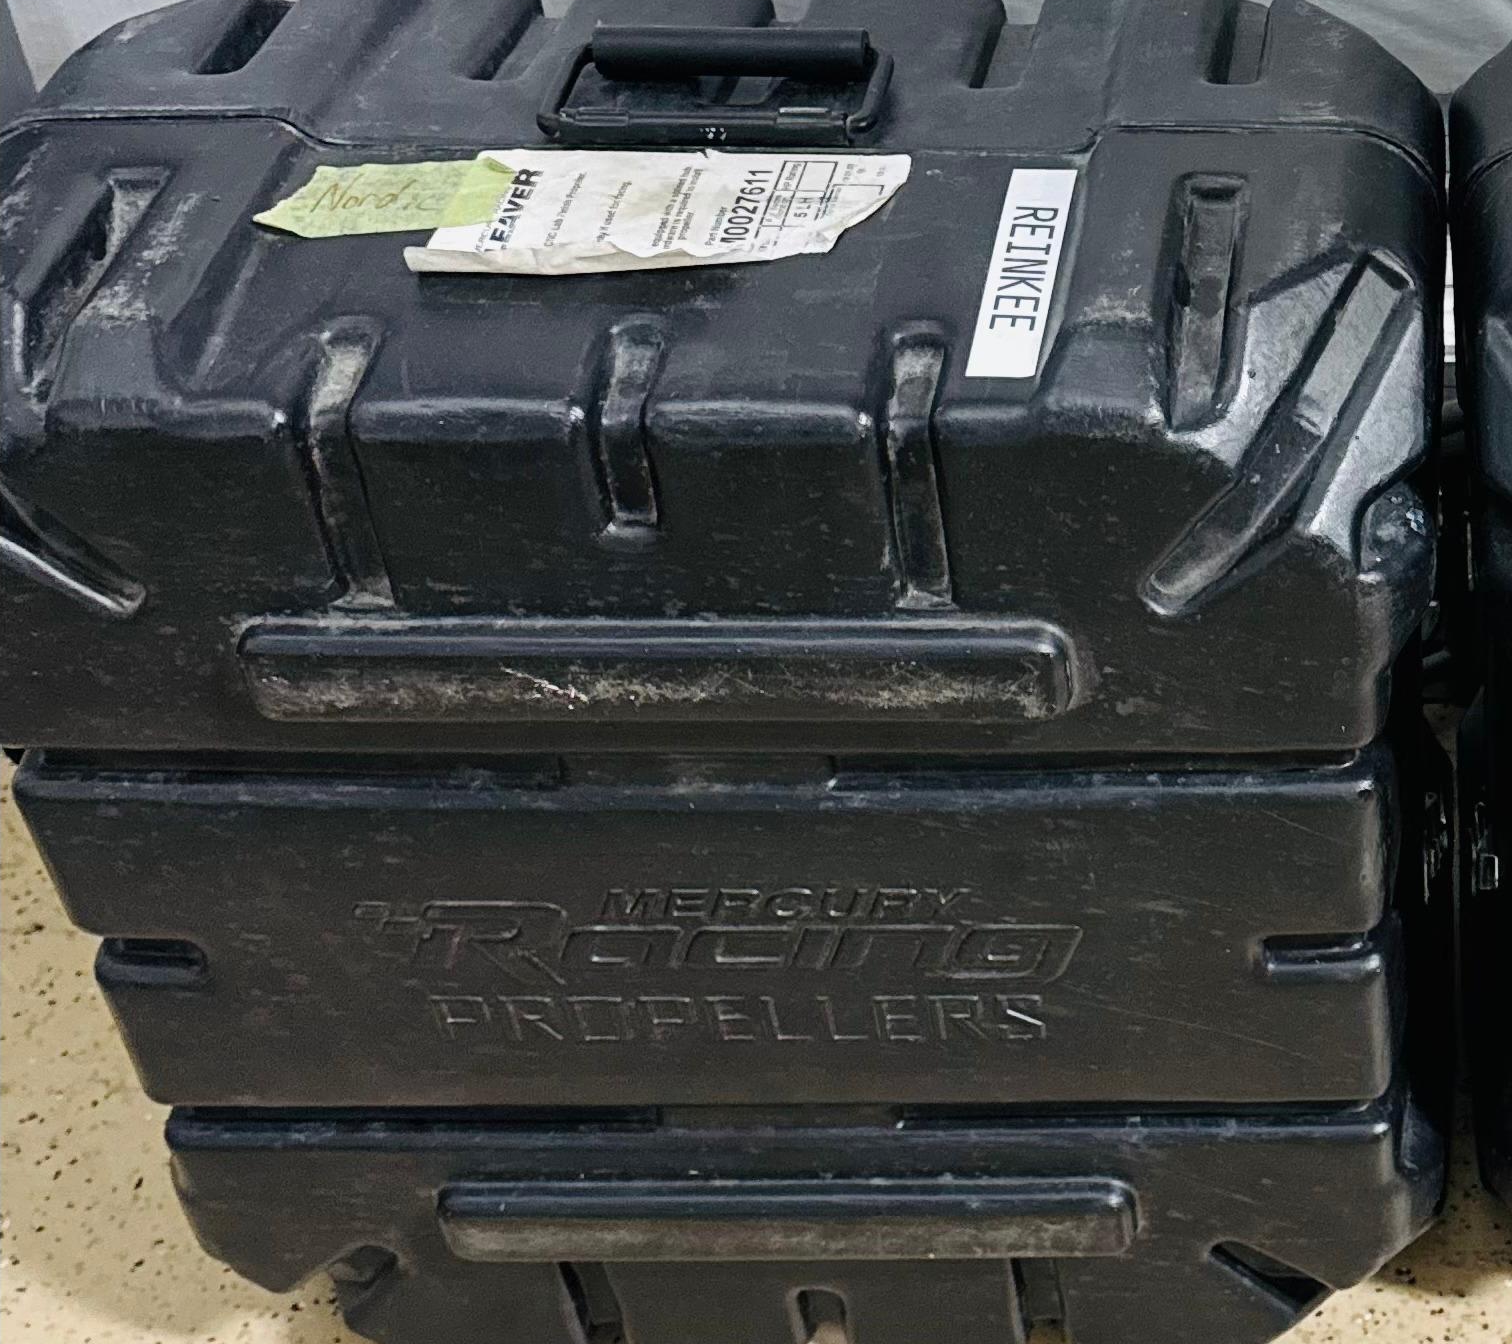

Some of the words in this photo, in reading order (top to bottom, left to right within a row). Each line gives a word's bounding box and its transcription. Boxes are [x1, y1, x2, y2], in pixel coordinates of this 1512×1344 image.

[310, 172, 440, 213] Nordic
[485, 169, 544, 253] EAVER
[711, 207, 728, 232] Number
[989, 206, 1059, 332] REINKEE
[601, 887, 972, 920] MERCURY
[406, 899, 1084, 984] Racing
[428, 994, 1048, 1042] PROPELLERS
